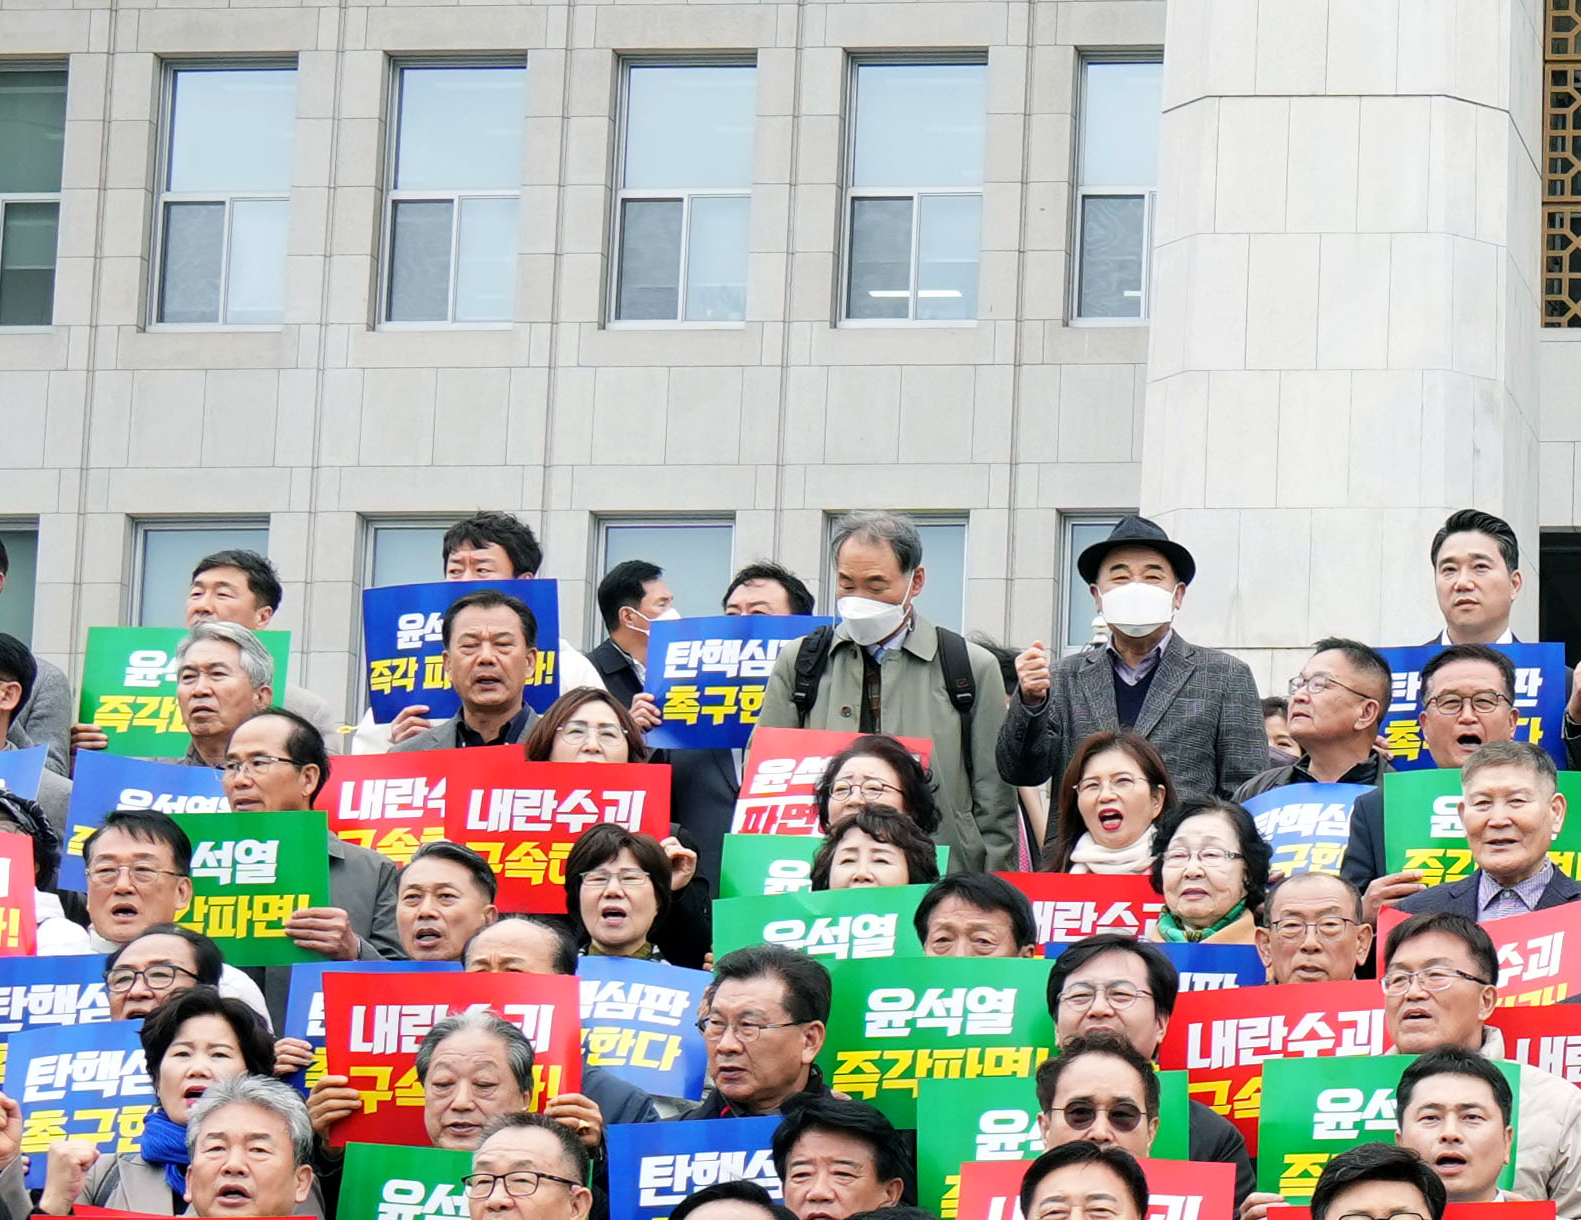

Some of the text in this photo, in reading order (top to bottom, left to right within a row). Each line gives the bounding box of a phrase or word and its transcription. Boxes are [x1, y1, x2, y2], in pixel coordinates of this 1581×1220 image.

[665, 636, 788, 677] 탄핵심
[467, 787, 642, 835] 내란수괴
[191, 838, 277, 886] 석열
[763, 914, 897, 958] 윤석열
[866, 988, 1016, 1037] 윤석열
[1188, 1005, 1385, 1068] 내란수괴
